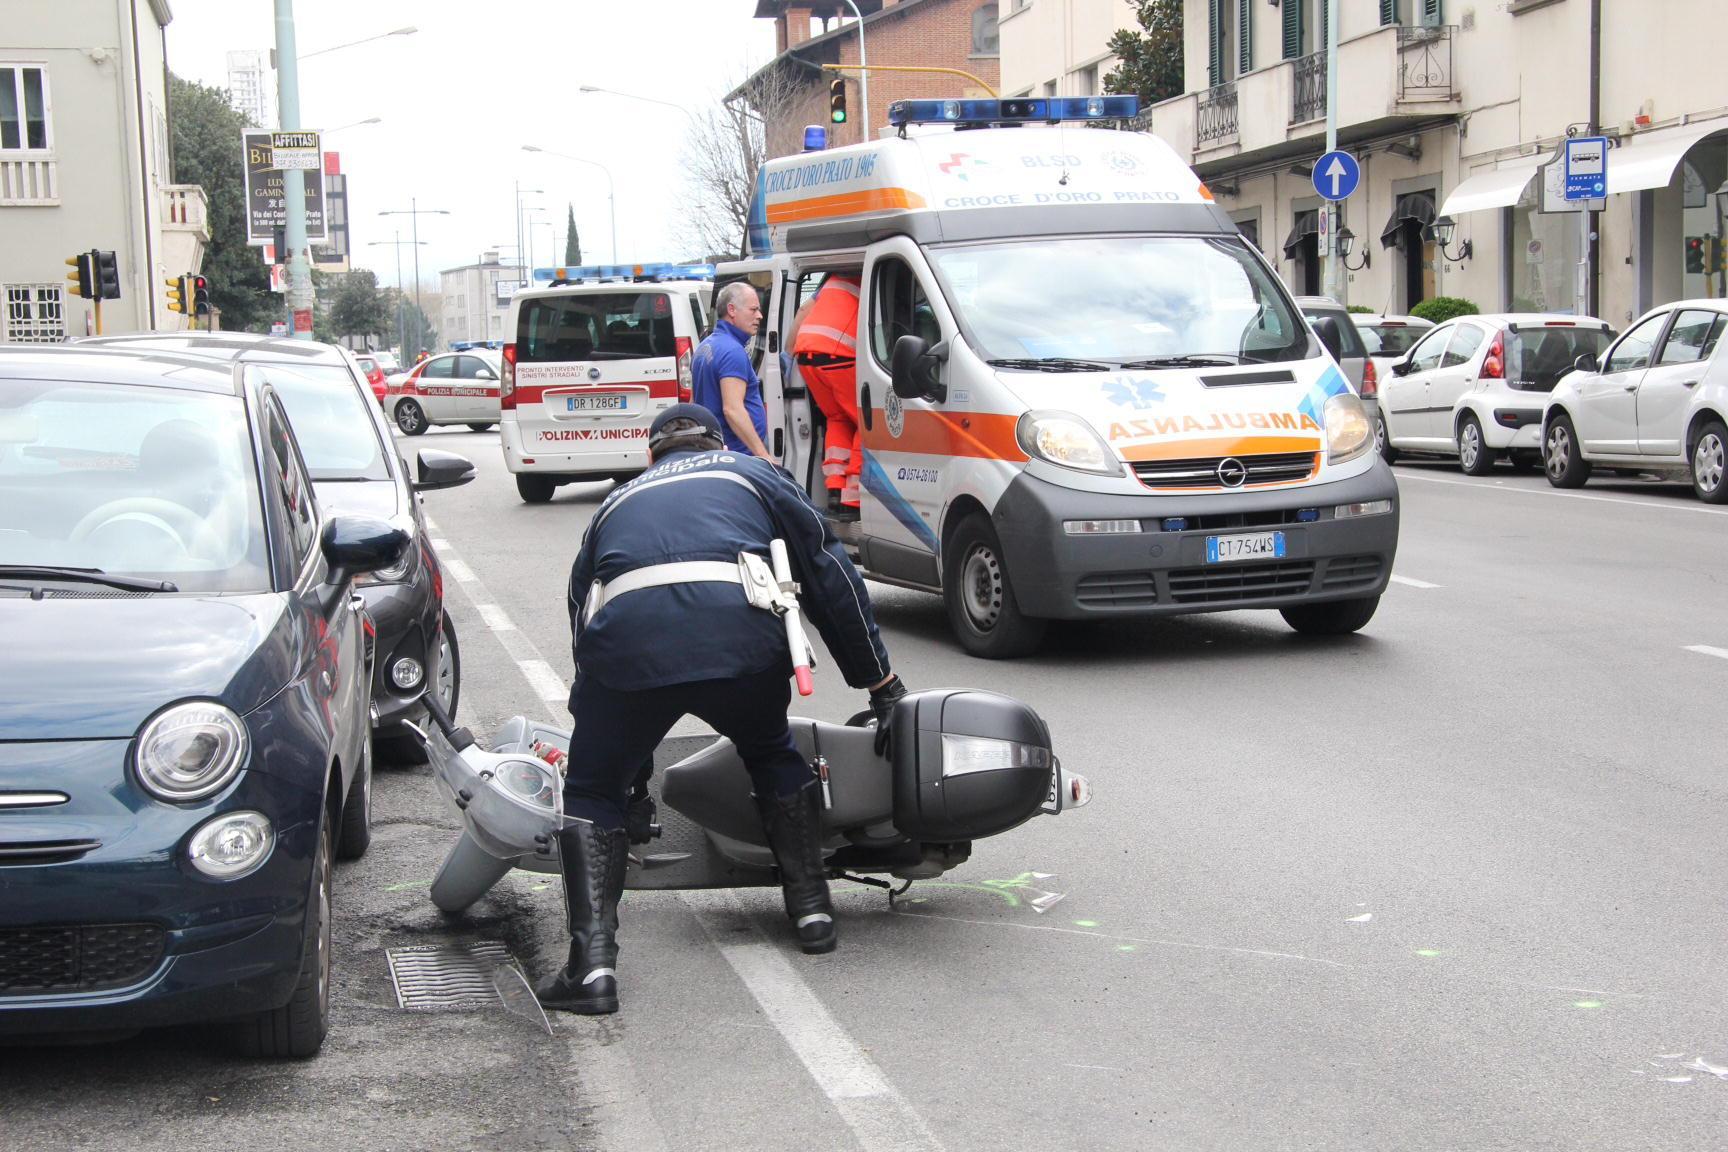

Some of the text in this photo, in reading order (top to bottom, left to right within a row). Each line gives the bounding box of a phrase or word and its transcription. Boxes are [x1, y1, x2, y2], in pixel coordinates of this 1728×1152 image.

[275, 133, 316, 147] AFFITTASI
[1019, 154, 1083, 168] BLSD
[765, 153, 878, 194] CROCE D'ORO PRATO 1905
[254, 188, 286, 197] GAMIN
[943, 190, 1181, 209] CROCE D'ORO PRATO
[306, 210, 322, 218] Prato
[427, 387, 488, 396] POLIZIA MUNICIPALE
[574, 397, 620, 409] DR 128GF
[1218, 540, 1233, 556] CT
[1237, 536, 1274, 555] 754WS
